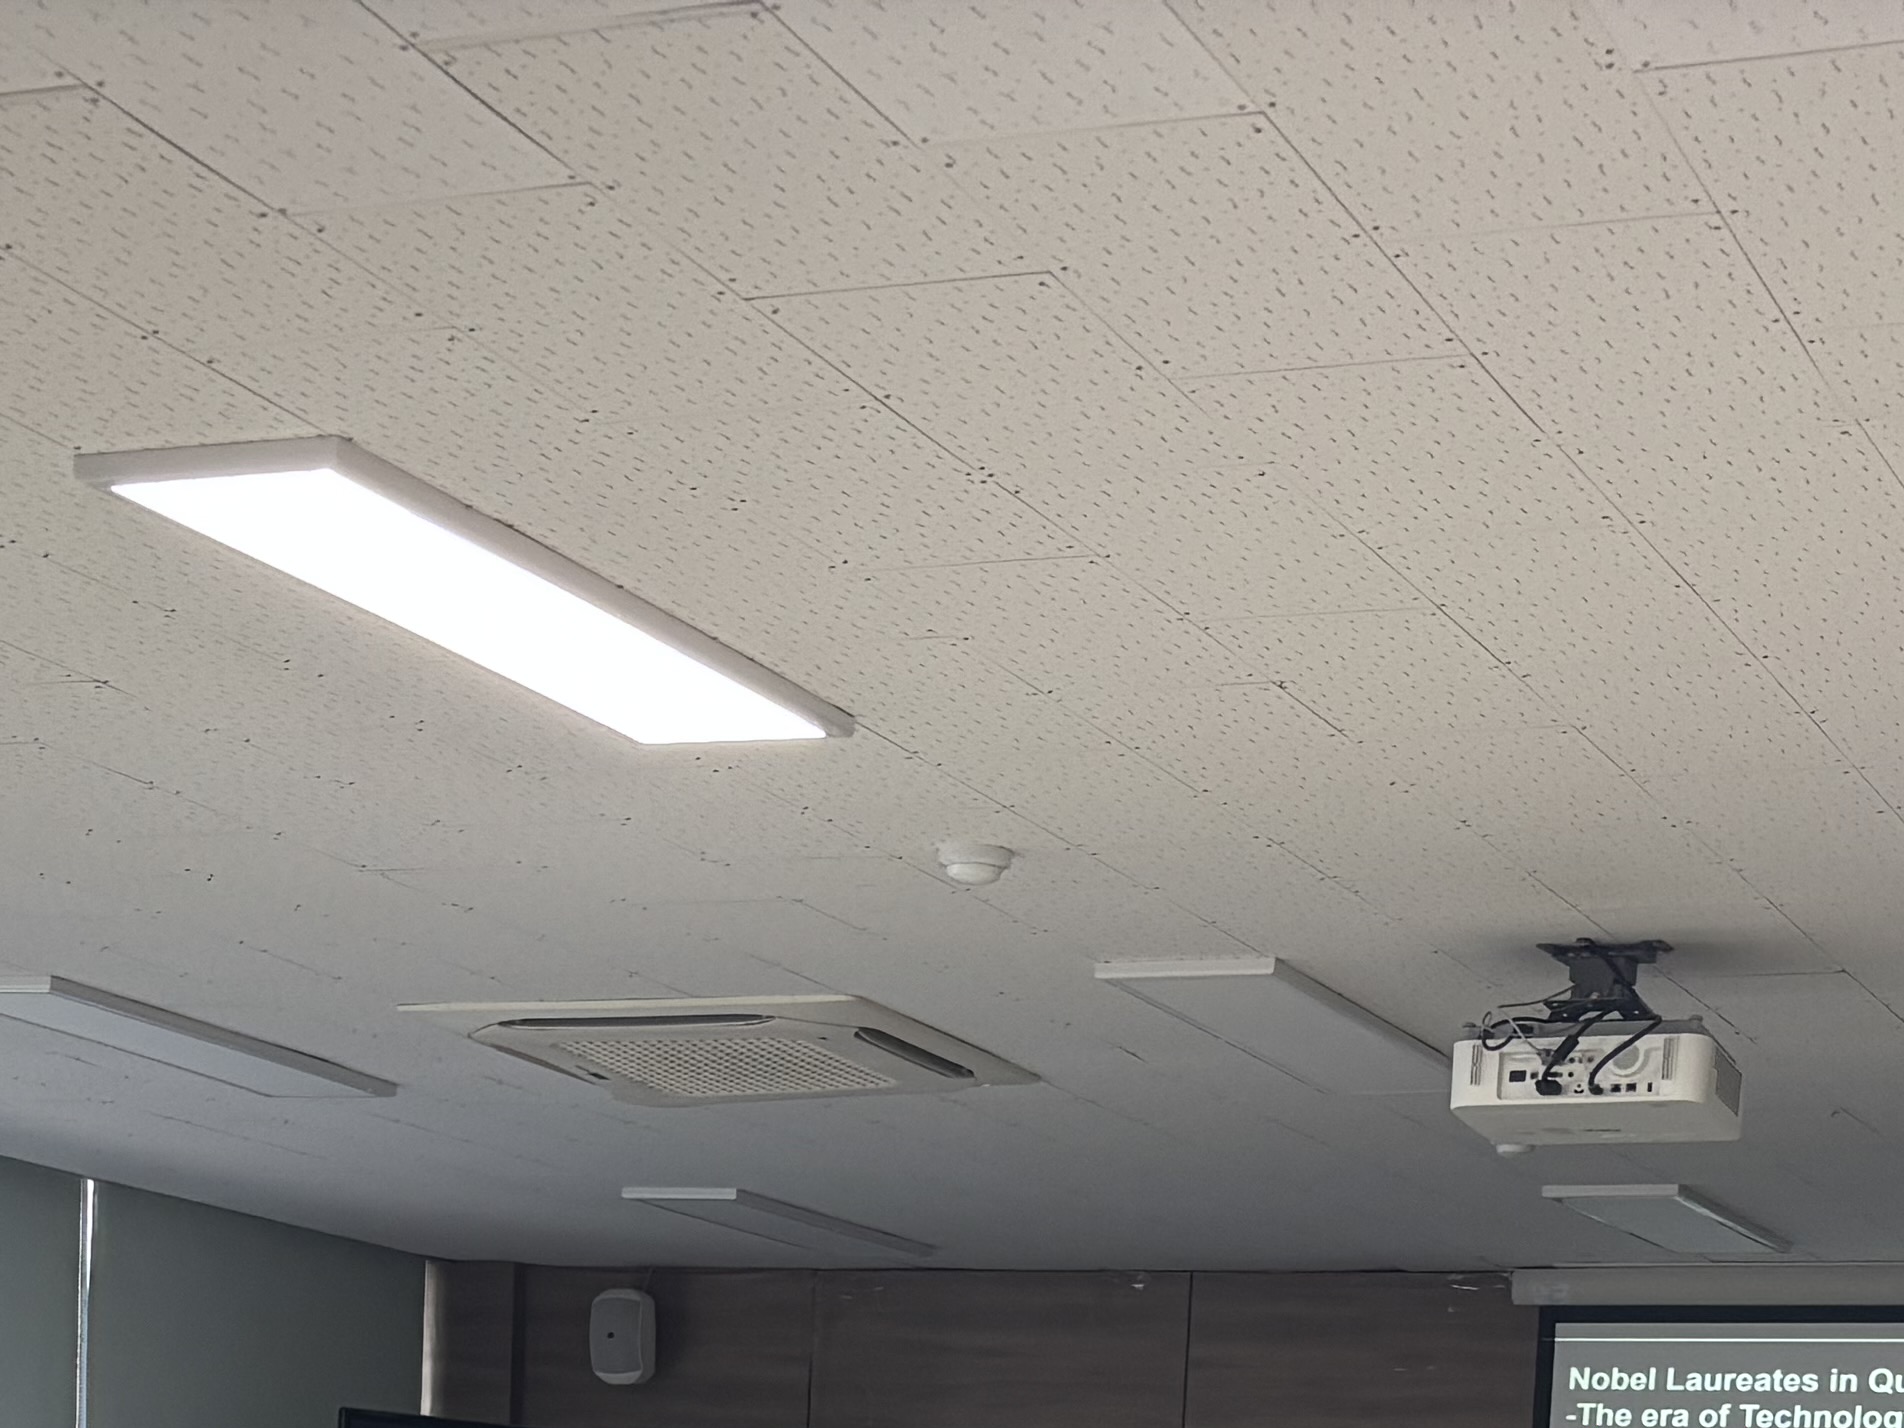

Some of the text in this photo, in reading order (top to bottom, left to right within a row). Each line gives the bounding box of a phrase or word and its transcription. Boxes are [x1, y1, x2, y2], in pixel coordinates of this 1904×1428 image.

[1569, 1366, 1656, 1391] Nobel
[1666, 1367, 1819, 1393] Laureates
[1830, 1368, 1858, 1392] in
[1566, 1403, 1632, 1427] -The
[1641, 1408, 1689, 1428] era
[1698, 1403, 1731, 1428] of
